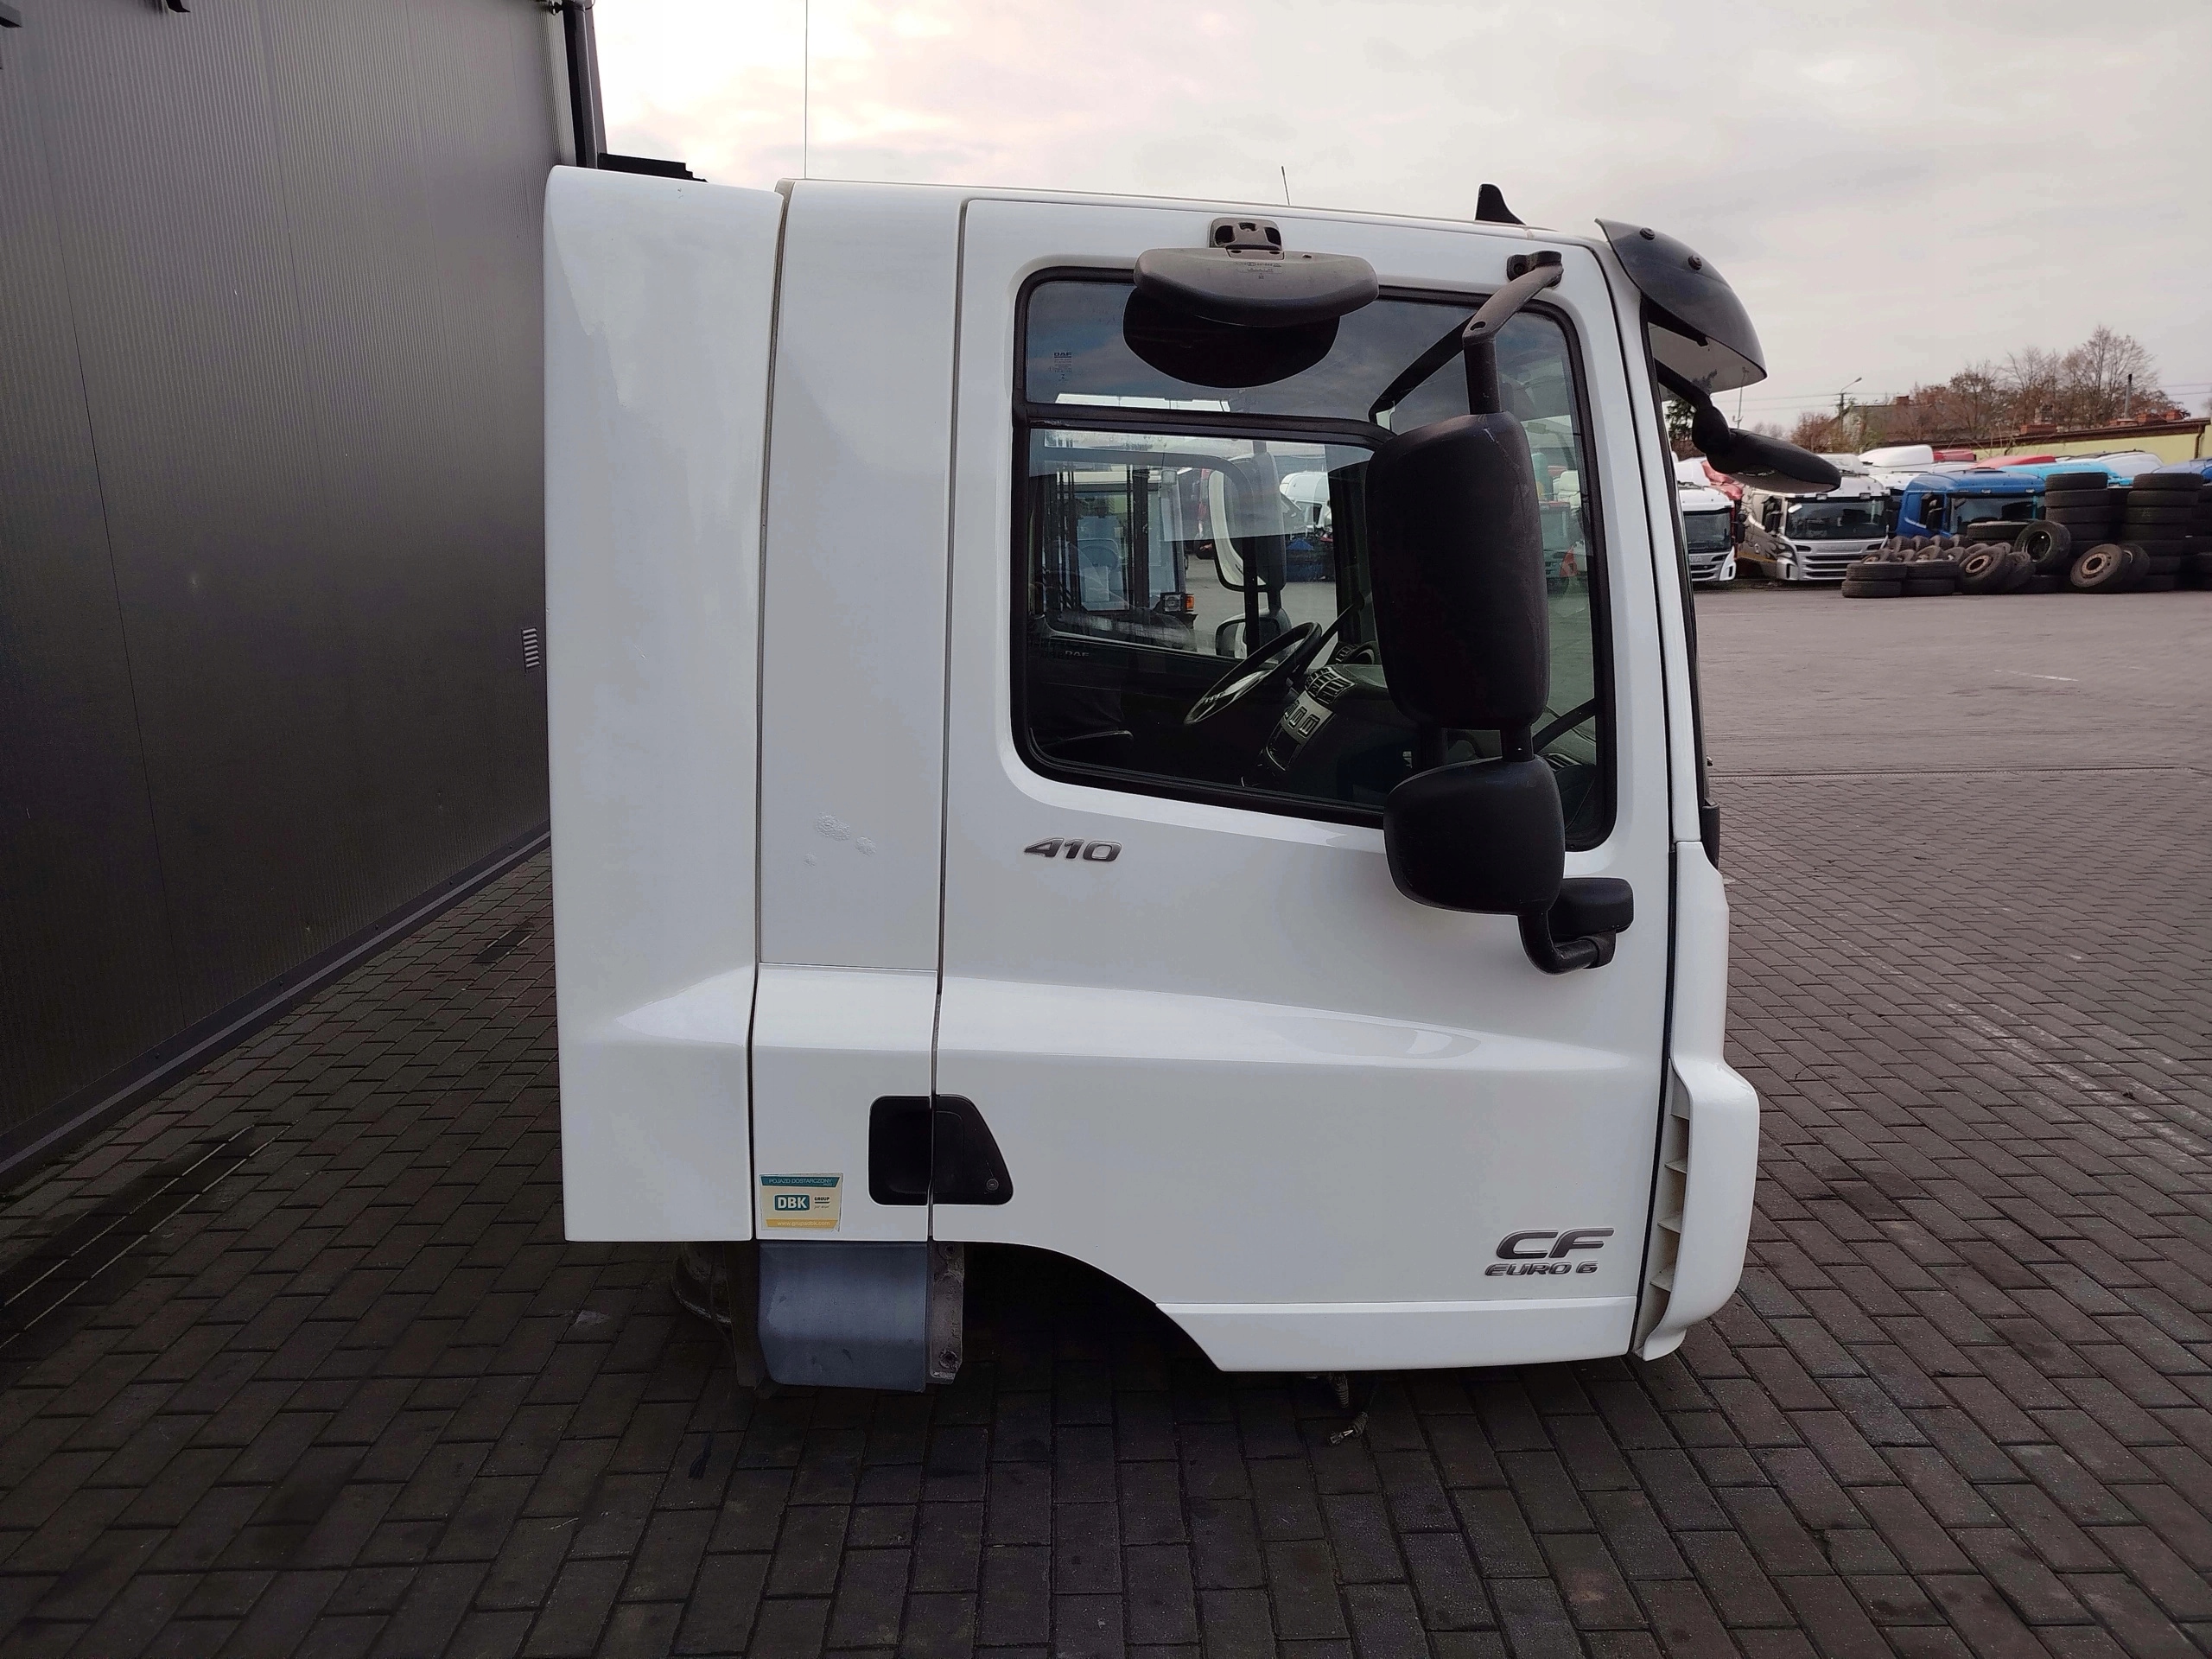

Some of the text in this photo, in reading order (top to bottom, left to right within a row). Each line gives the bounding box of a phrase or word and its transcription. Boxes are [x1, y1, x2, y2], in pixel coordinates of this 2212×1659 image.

[1024, 837, 1122, 862] 410
[778, 1196, 807, 1209] DBK
[1496, 1227, 1615, 1259] CF
[1484, 1260, 1599, 1276] EURO 6
